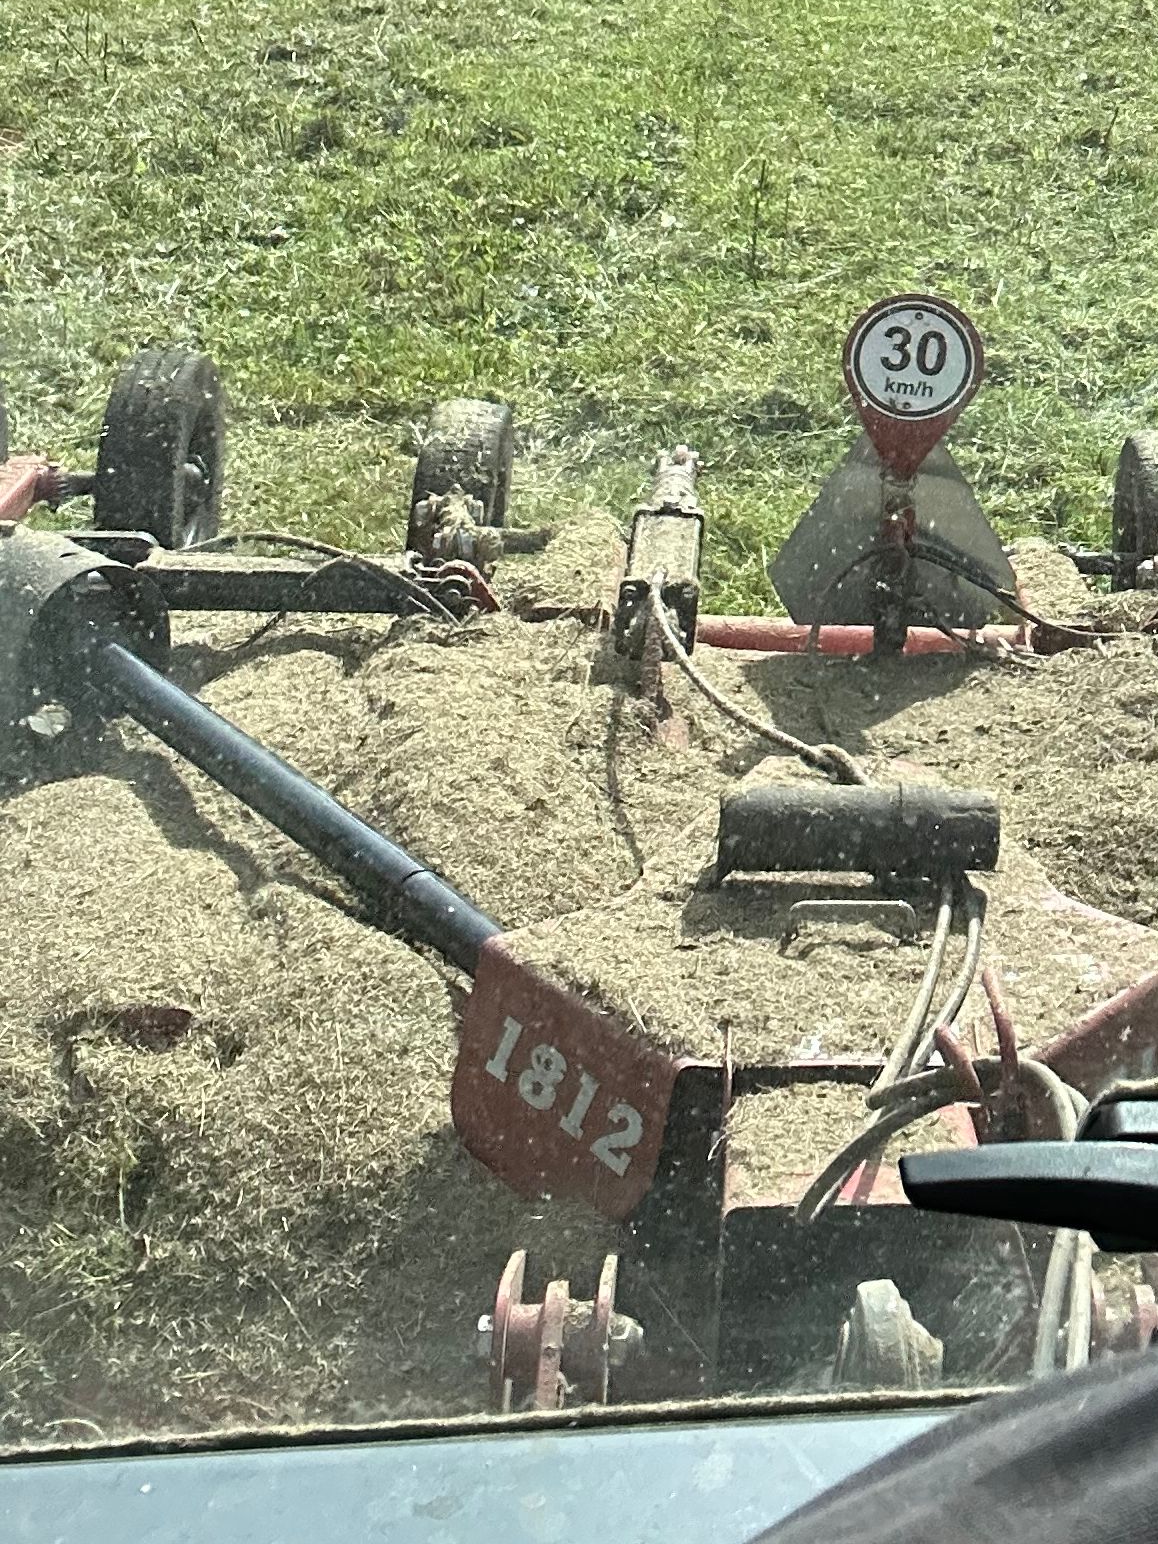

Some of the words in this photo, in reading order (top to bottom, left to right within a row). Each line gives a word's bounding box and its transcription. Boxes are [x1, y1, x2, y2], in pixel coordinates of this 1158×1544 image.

[880, 326, 947, 376] 30
[884, 377, 934, 398] km/h
[485, 1016, 644, 1177] 1812
